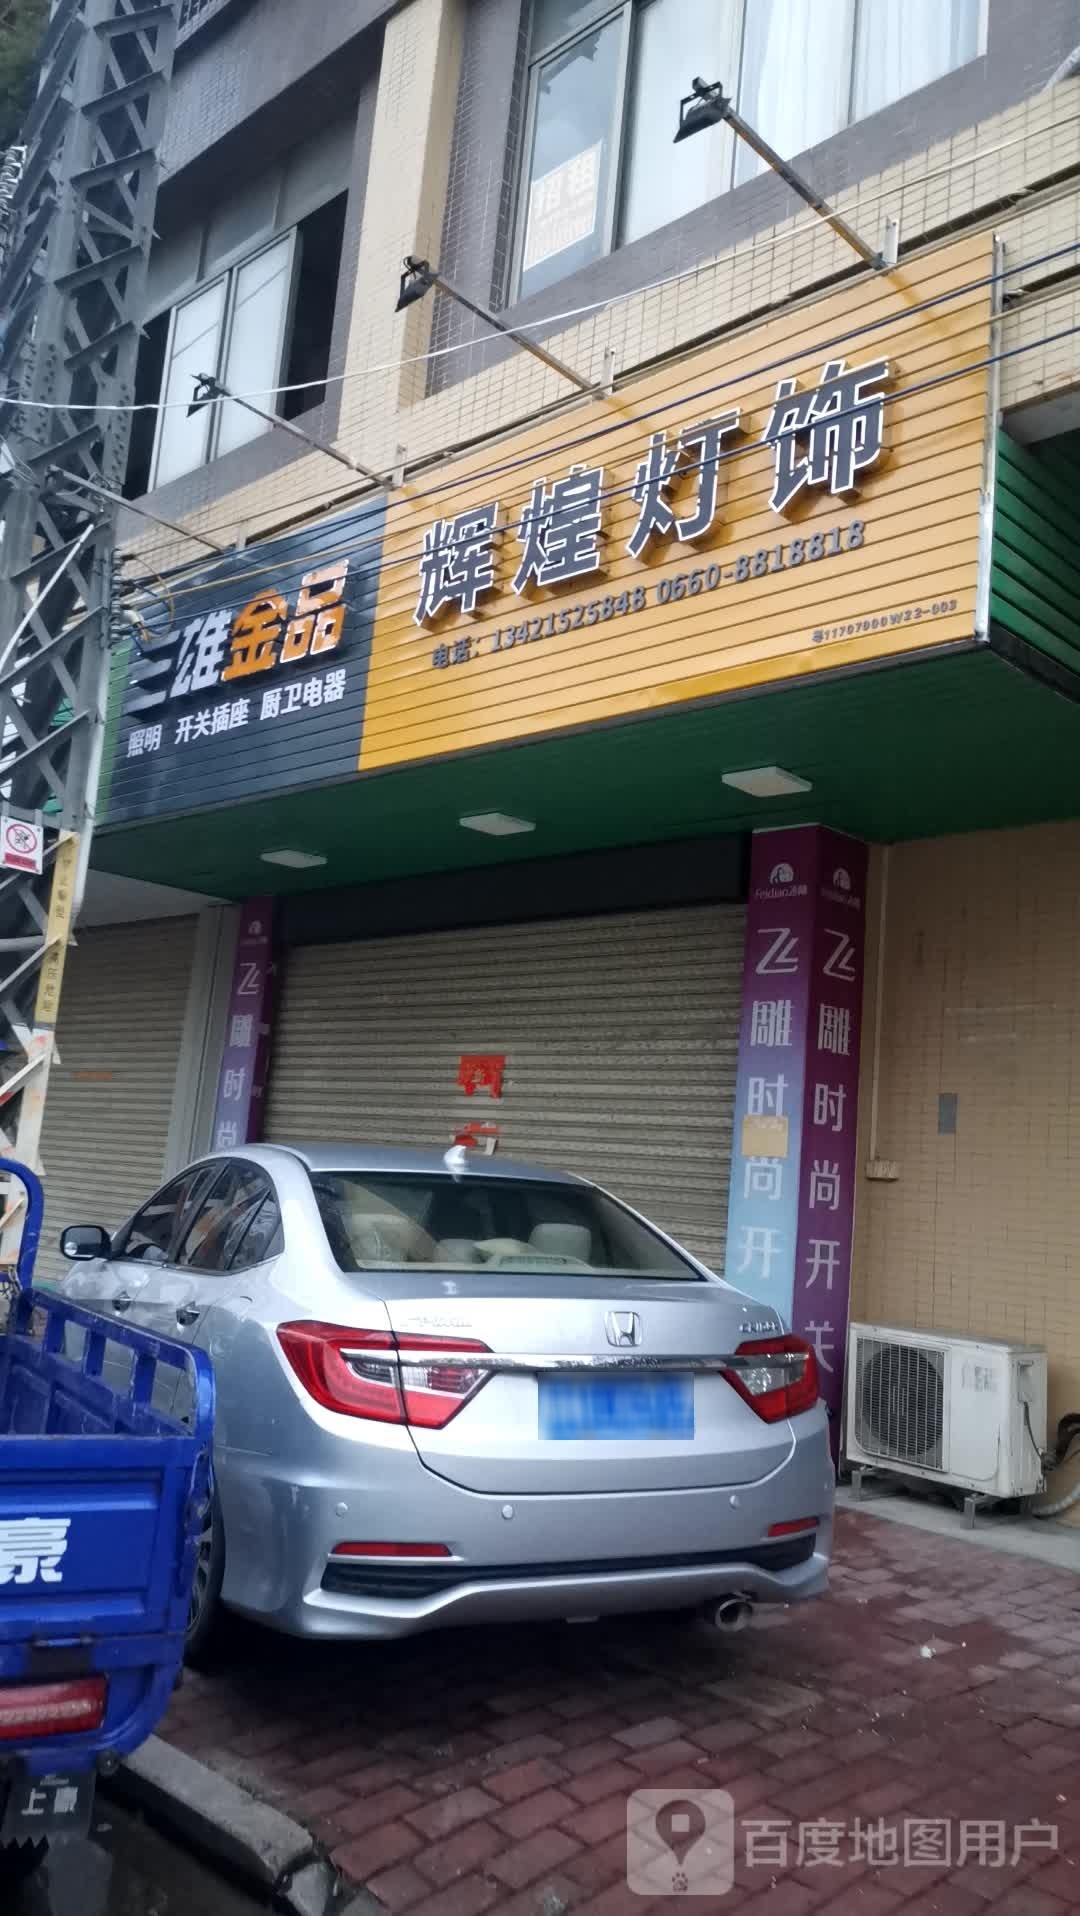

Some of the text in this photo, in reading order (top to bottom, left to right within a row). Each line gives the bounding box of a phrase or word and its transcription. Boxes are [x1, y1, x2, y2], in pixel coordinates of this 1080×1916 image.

[412, 357, 893, 628] 辉煌灯饰
[656, 519, 867, 601] 0660-8818818
[125, 559, 350, 713] 三雄金品
[126, 668, 347, 759] 照明 开关插座 厨卫电器
